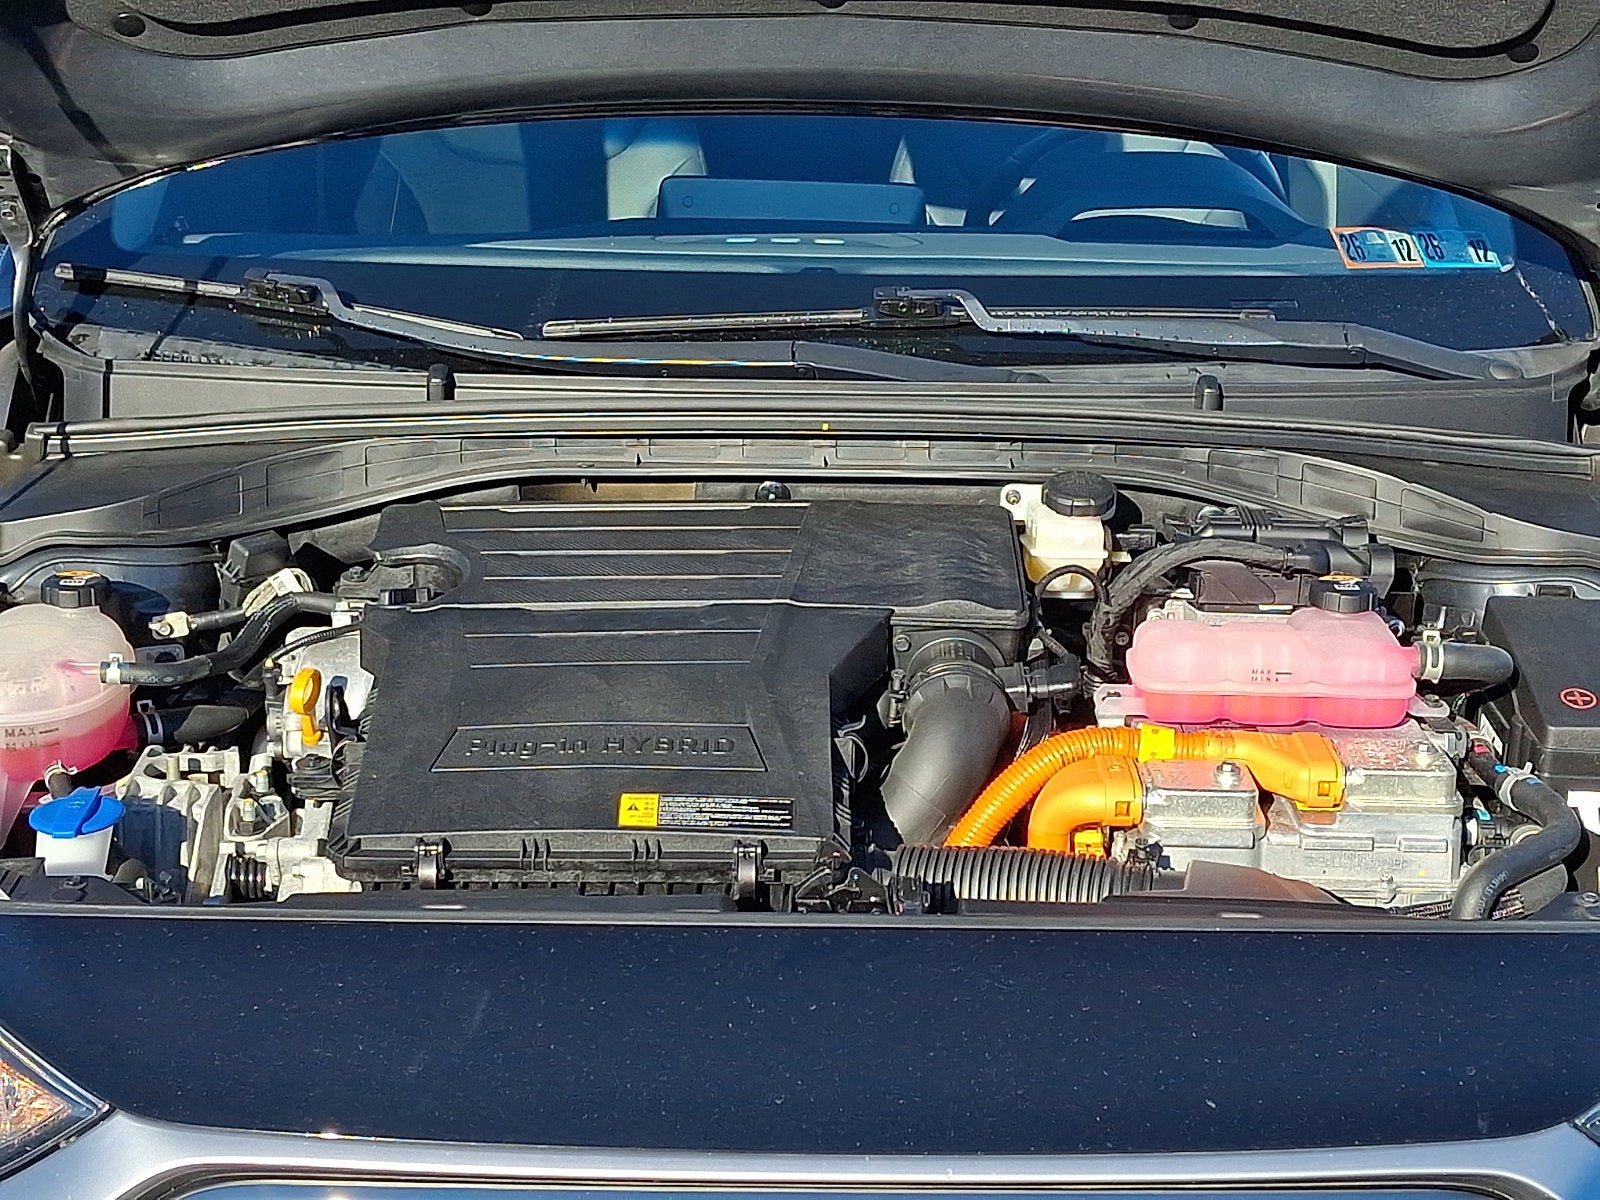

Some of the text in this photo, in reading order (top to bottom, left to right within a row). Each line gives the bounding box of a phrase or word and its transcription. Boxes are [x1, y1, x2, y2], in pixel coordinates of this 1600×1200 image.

[1338, 233, 1418, 262] 26 12
[1417, 232, 1495, 263] 26 12
[4, 727, 36, 738] MAX
[465, 736, 736, 760] Plug-in HYBRID
